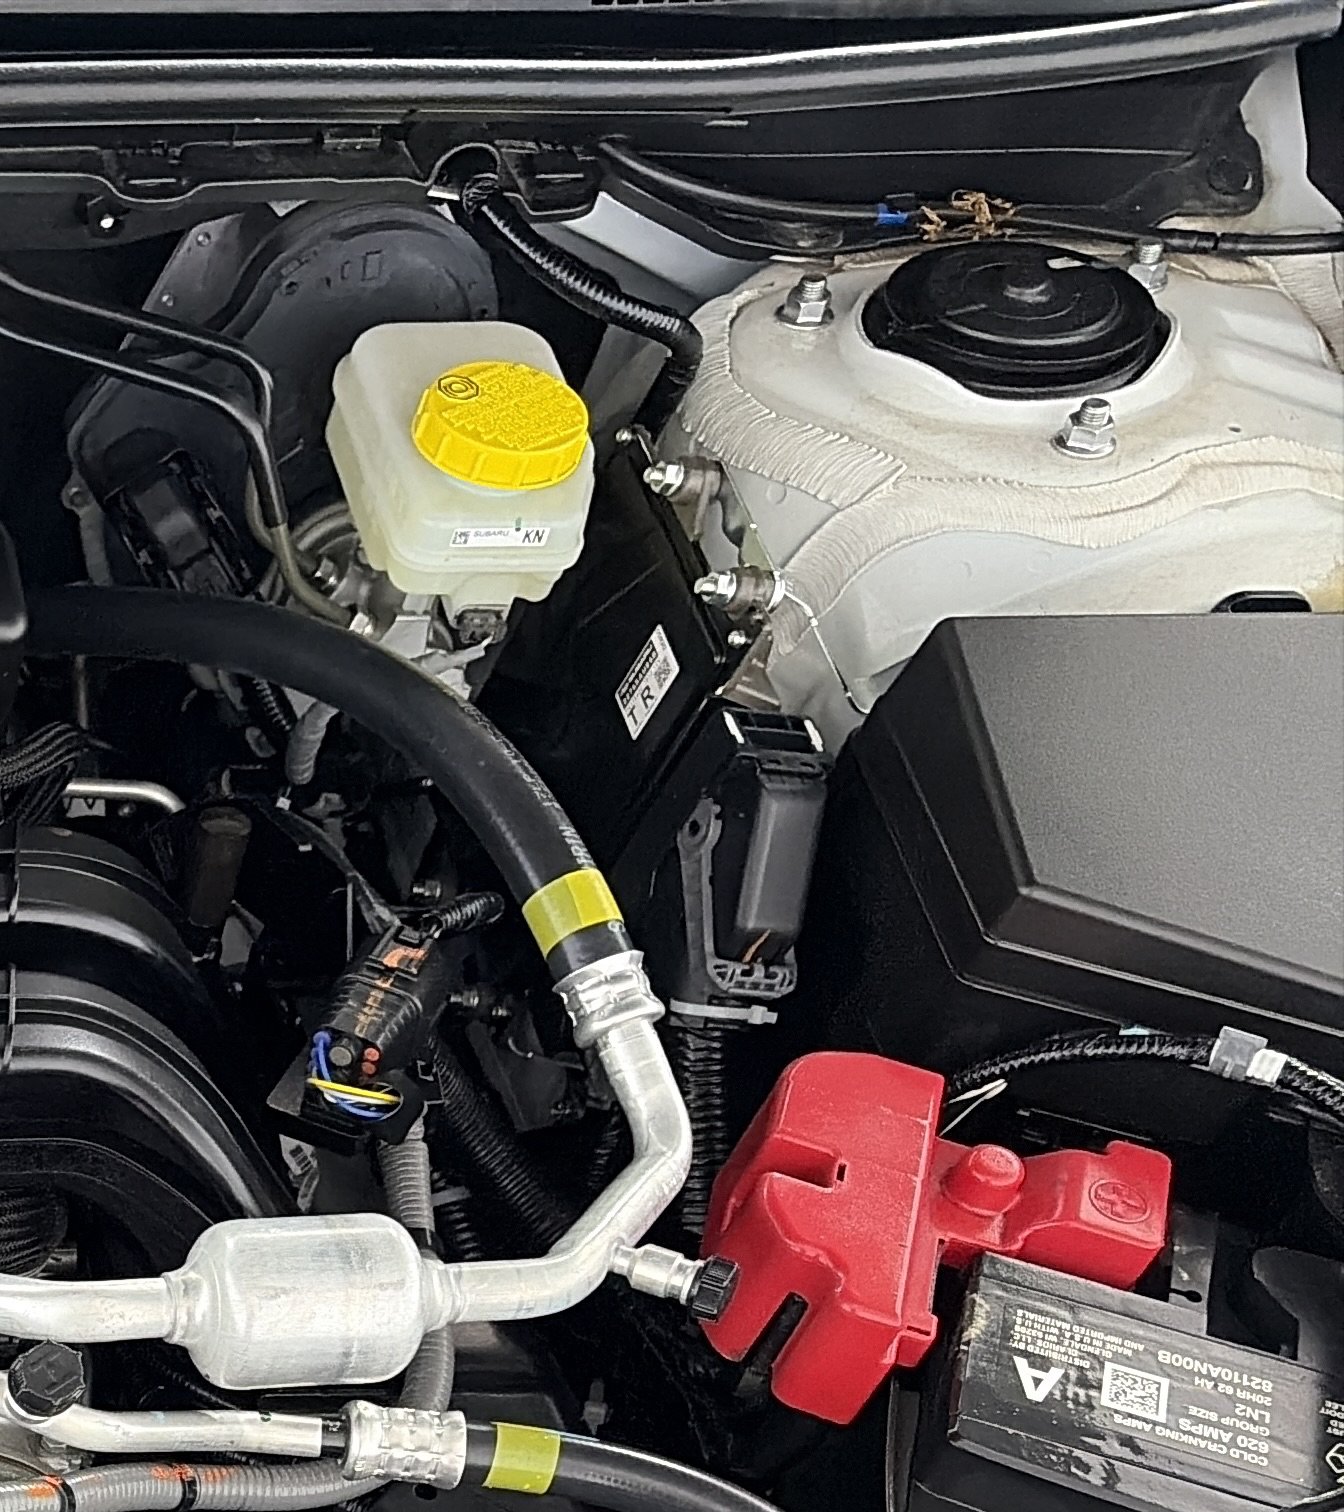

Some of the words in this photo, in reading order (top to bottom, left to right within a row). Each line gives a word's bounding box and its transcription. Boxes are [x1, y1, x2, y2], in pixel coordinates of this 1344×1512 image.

[522, 529, 545, 543] KN
[1016, 1309, 1071, 1330] MATERIALS
[1033, 1322, 1059, 1335] WITH
[1073, 1325, 1123, 1345] IMPORTED
[1104, 1340, 1133, 1357] MADE
[1124, 1339, 1145, 1352] AND
[1026, 1344, 1090, 1369] DISTRIBUTED
[1012, 1355, 1066, 1402] A
[1157, 1350, 1273, 1393] 82110AN00B
[1194, 1375, 1215, 1390] AH
[1217, 1381, 1234, 1395] 62
[1236, 1387, 1273, 1407] 20HR
[1113, 1413, 1153, 1433] AMPS
[1187, 1405, 1218, 1422] SIZE
[1234, 1403, 1271, 1424] LN2
[1178, 1417, 1234, 1443] AMPS
[1220, 1416, 1270, 1437] GROUP
[1154, 1425, 1228, 1455] CRANKING
[1236, 1435, 1269, 1454] 620
[1229, 1448, 1269, 1467] COLD
